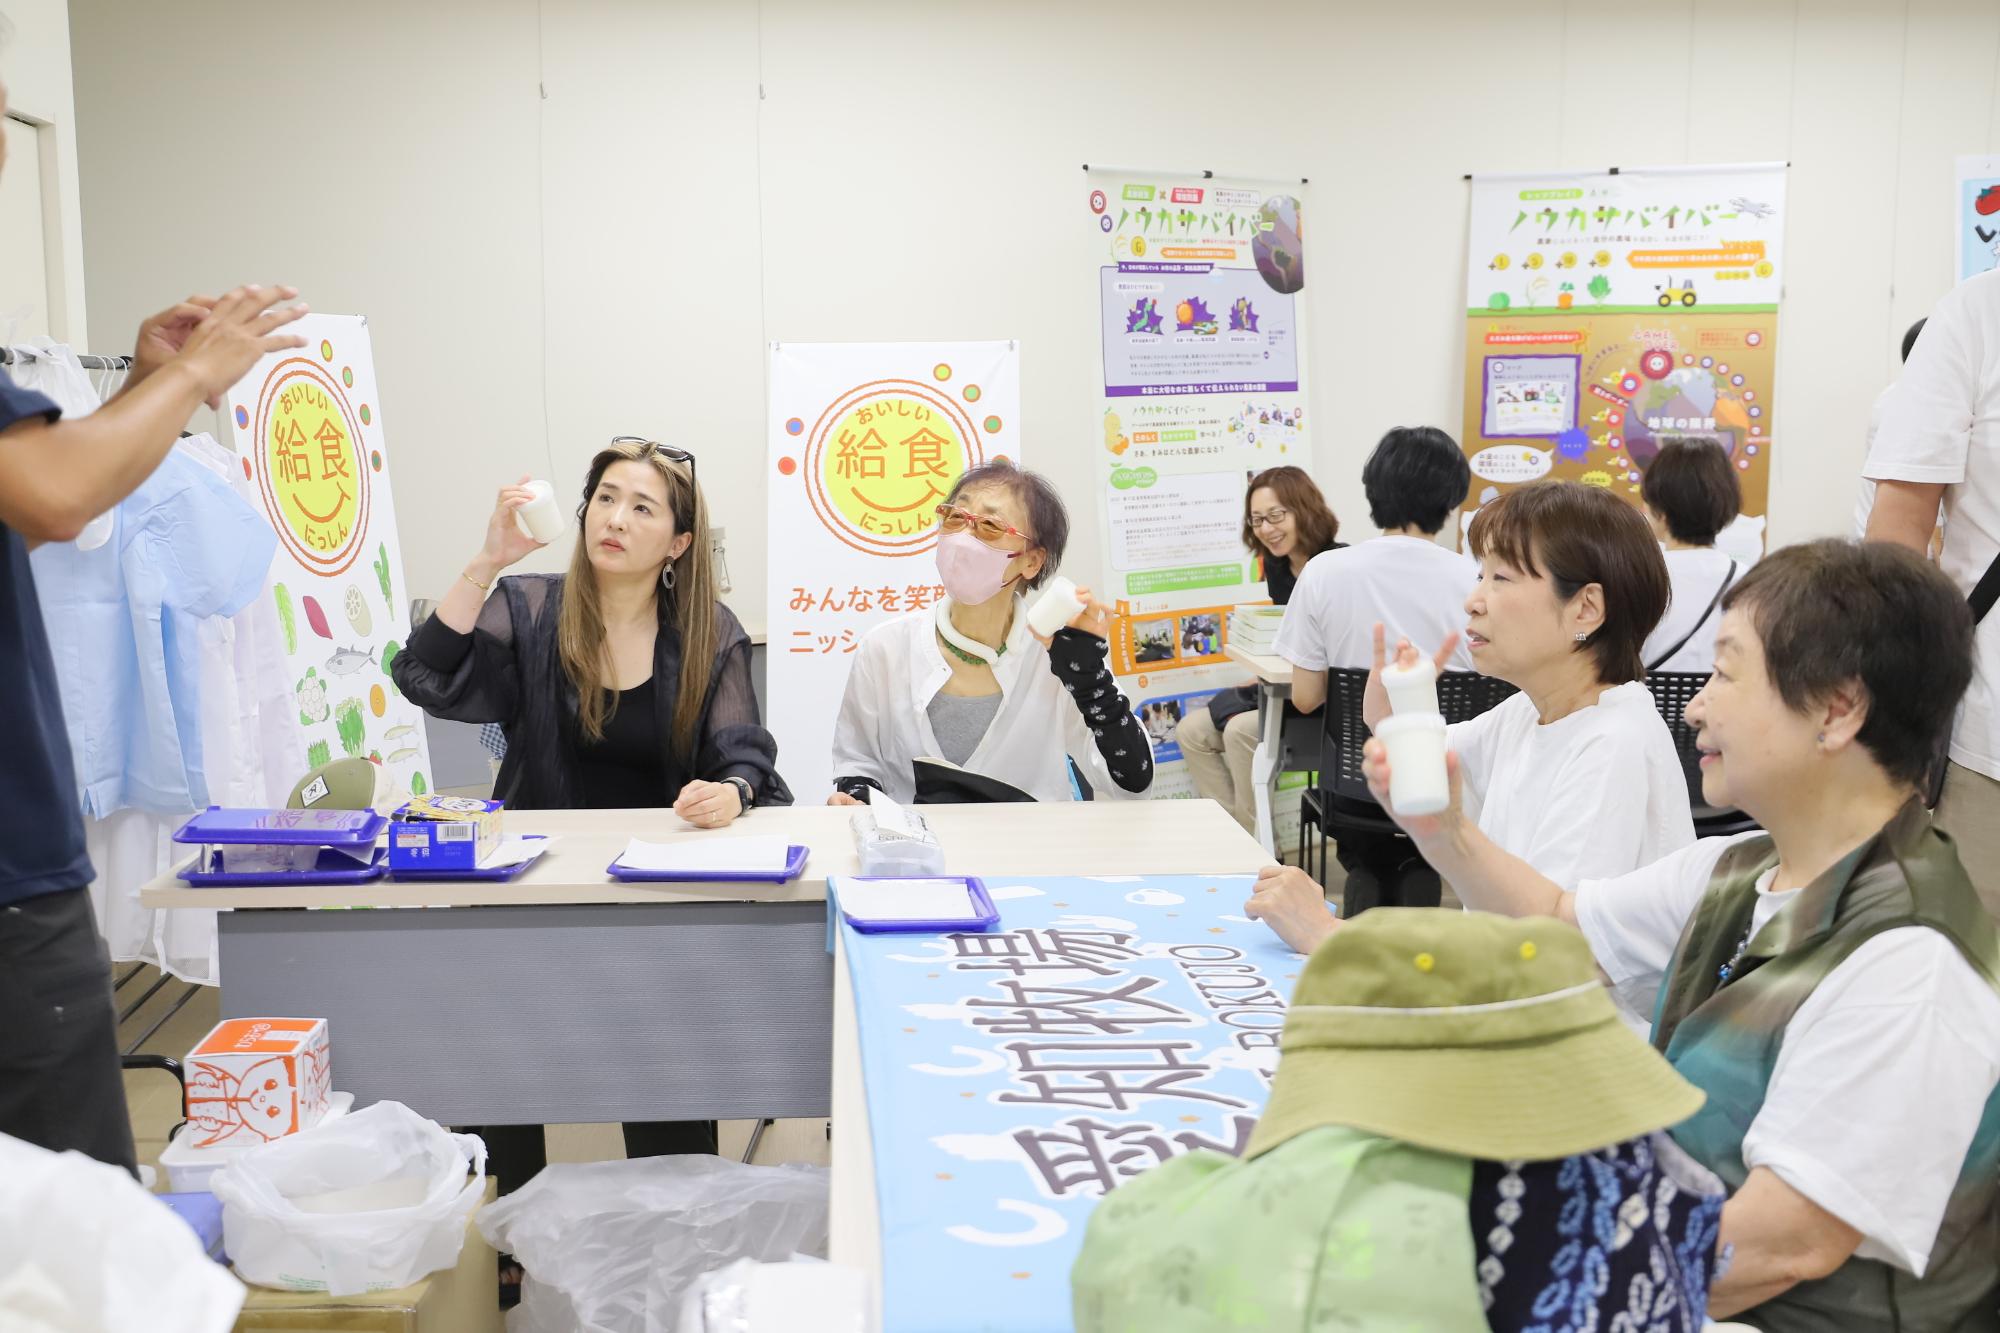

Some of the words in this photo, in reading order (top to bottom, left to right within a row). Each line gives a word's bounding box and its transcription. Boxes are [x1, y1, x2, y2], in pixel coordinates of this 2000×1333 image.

[1116, 206, 1275, 236] ノウカサバイバー
[1509, 204, 1739, 234] ノウカサバイバー
[280, 383, 329, 415] おいしい
[856, 400, 931, 425] おいしい
[1648, 417, 1716, 430] 地球の限界
[275, 418, 349, 483] 給食
[837, 427, 950, 479] 給食
[304, 521, 348, 550] にっしん
[860, 512, 932, 535] にっしん
[790, 629, 859, 654] ニッシ
